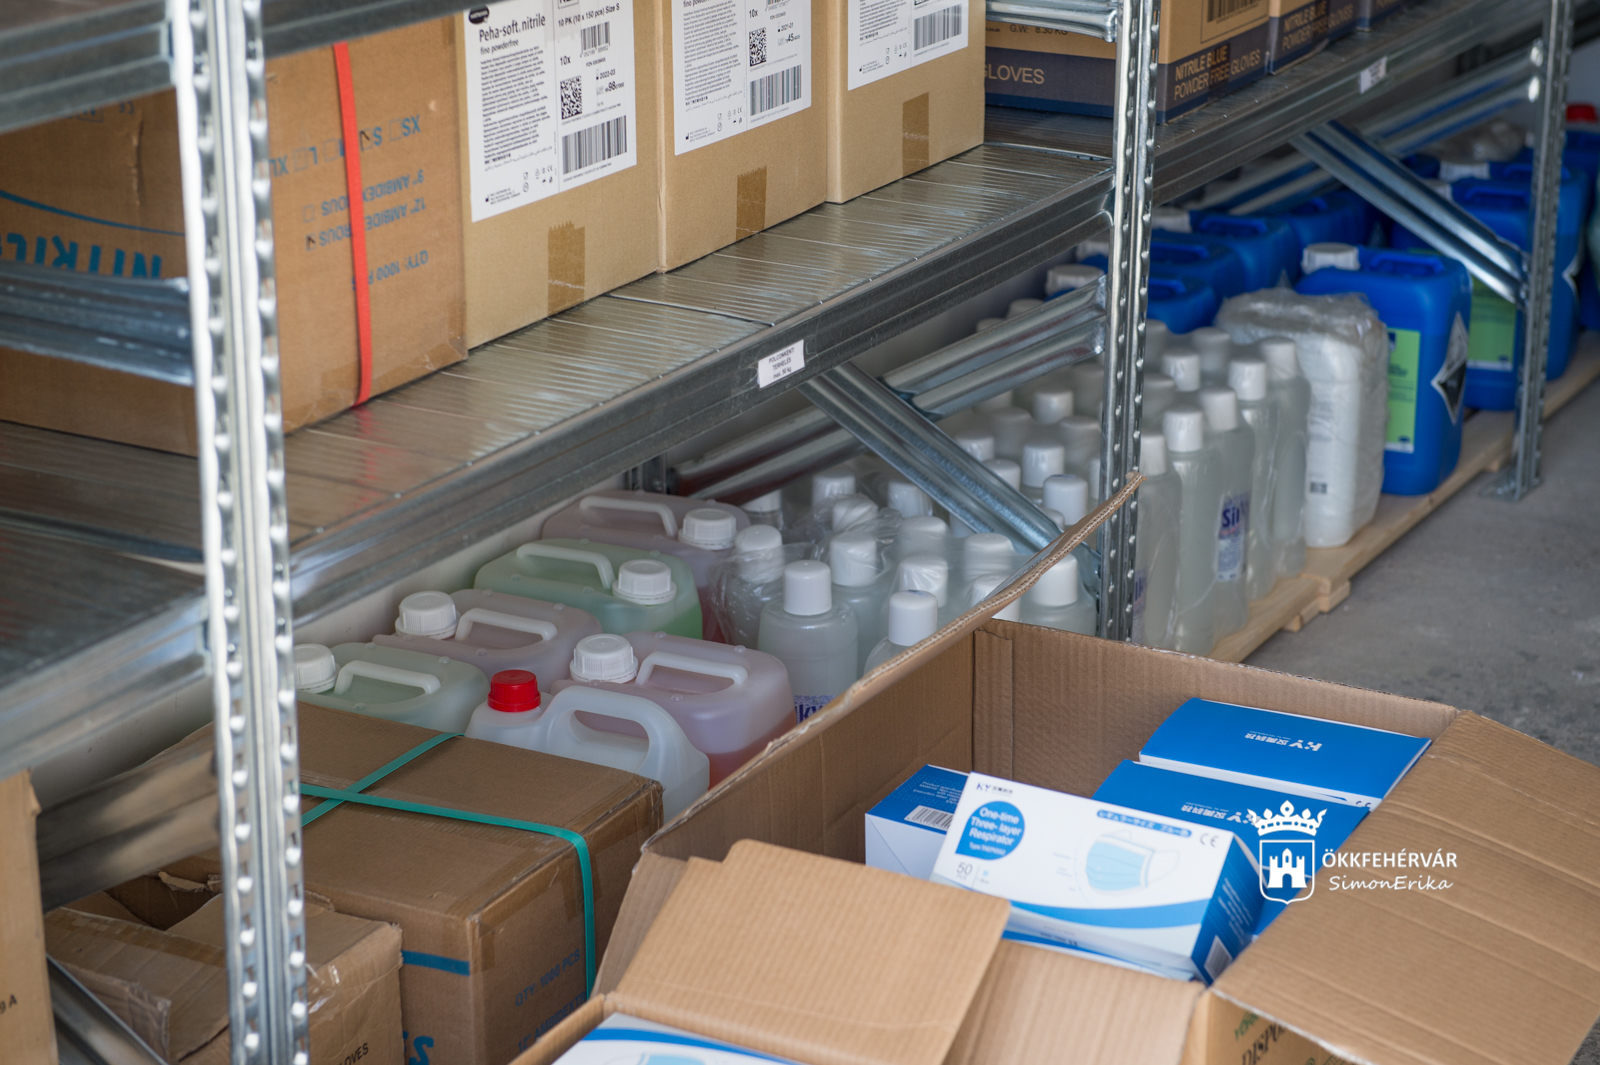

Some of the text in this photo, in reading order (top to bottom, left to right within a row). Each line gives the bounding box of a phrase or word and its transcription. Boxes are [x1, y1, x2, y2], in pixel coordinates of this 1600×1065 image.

[521, 13, 546, 32] nitrile
[564, 16, 573, 26] PK
[605, 5, 616, 14] Size
[615, 2, 620, 11] S
[749, 9, 758, 18] 10x
[491, 38, 519, 54] powderfree
[559, 55, 571, 66] 10x
[1175, 44, 1228, 82] NITRILE BLUE
[1174, 48, 1262, 101] POWDER FREE GLOVES
[372, 126, 383, 146] S
[401, 114, 422, 137] XS
[308, 146, 319, 165] L
[320, 173, 411, 217] AMBIDEXOUS
[318, 203, 408, 247] AMBIDEROUS
[0, 232, 163, 279] NITRIL
[403, 249, 429, 271] QTY:
[376, 260, 401, 282] 1000
[979, 806, 1020, 825] One-time
[969, 827, 1015, 846] Respirator
[998, 822, 1022, 837] layer
[957, 862, 973, 876] 50
[515, 948, 581, 1007] QTY: 1000 PCS
